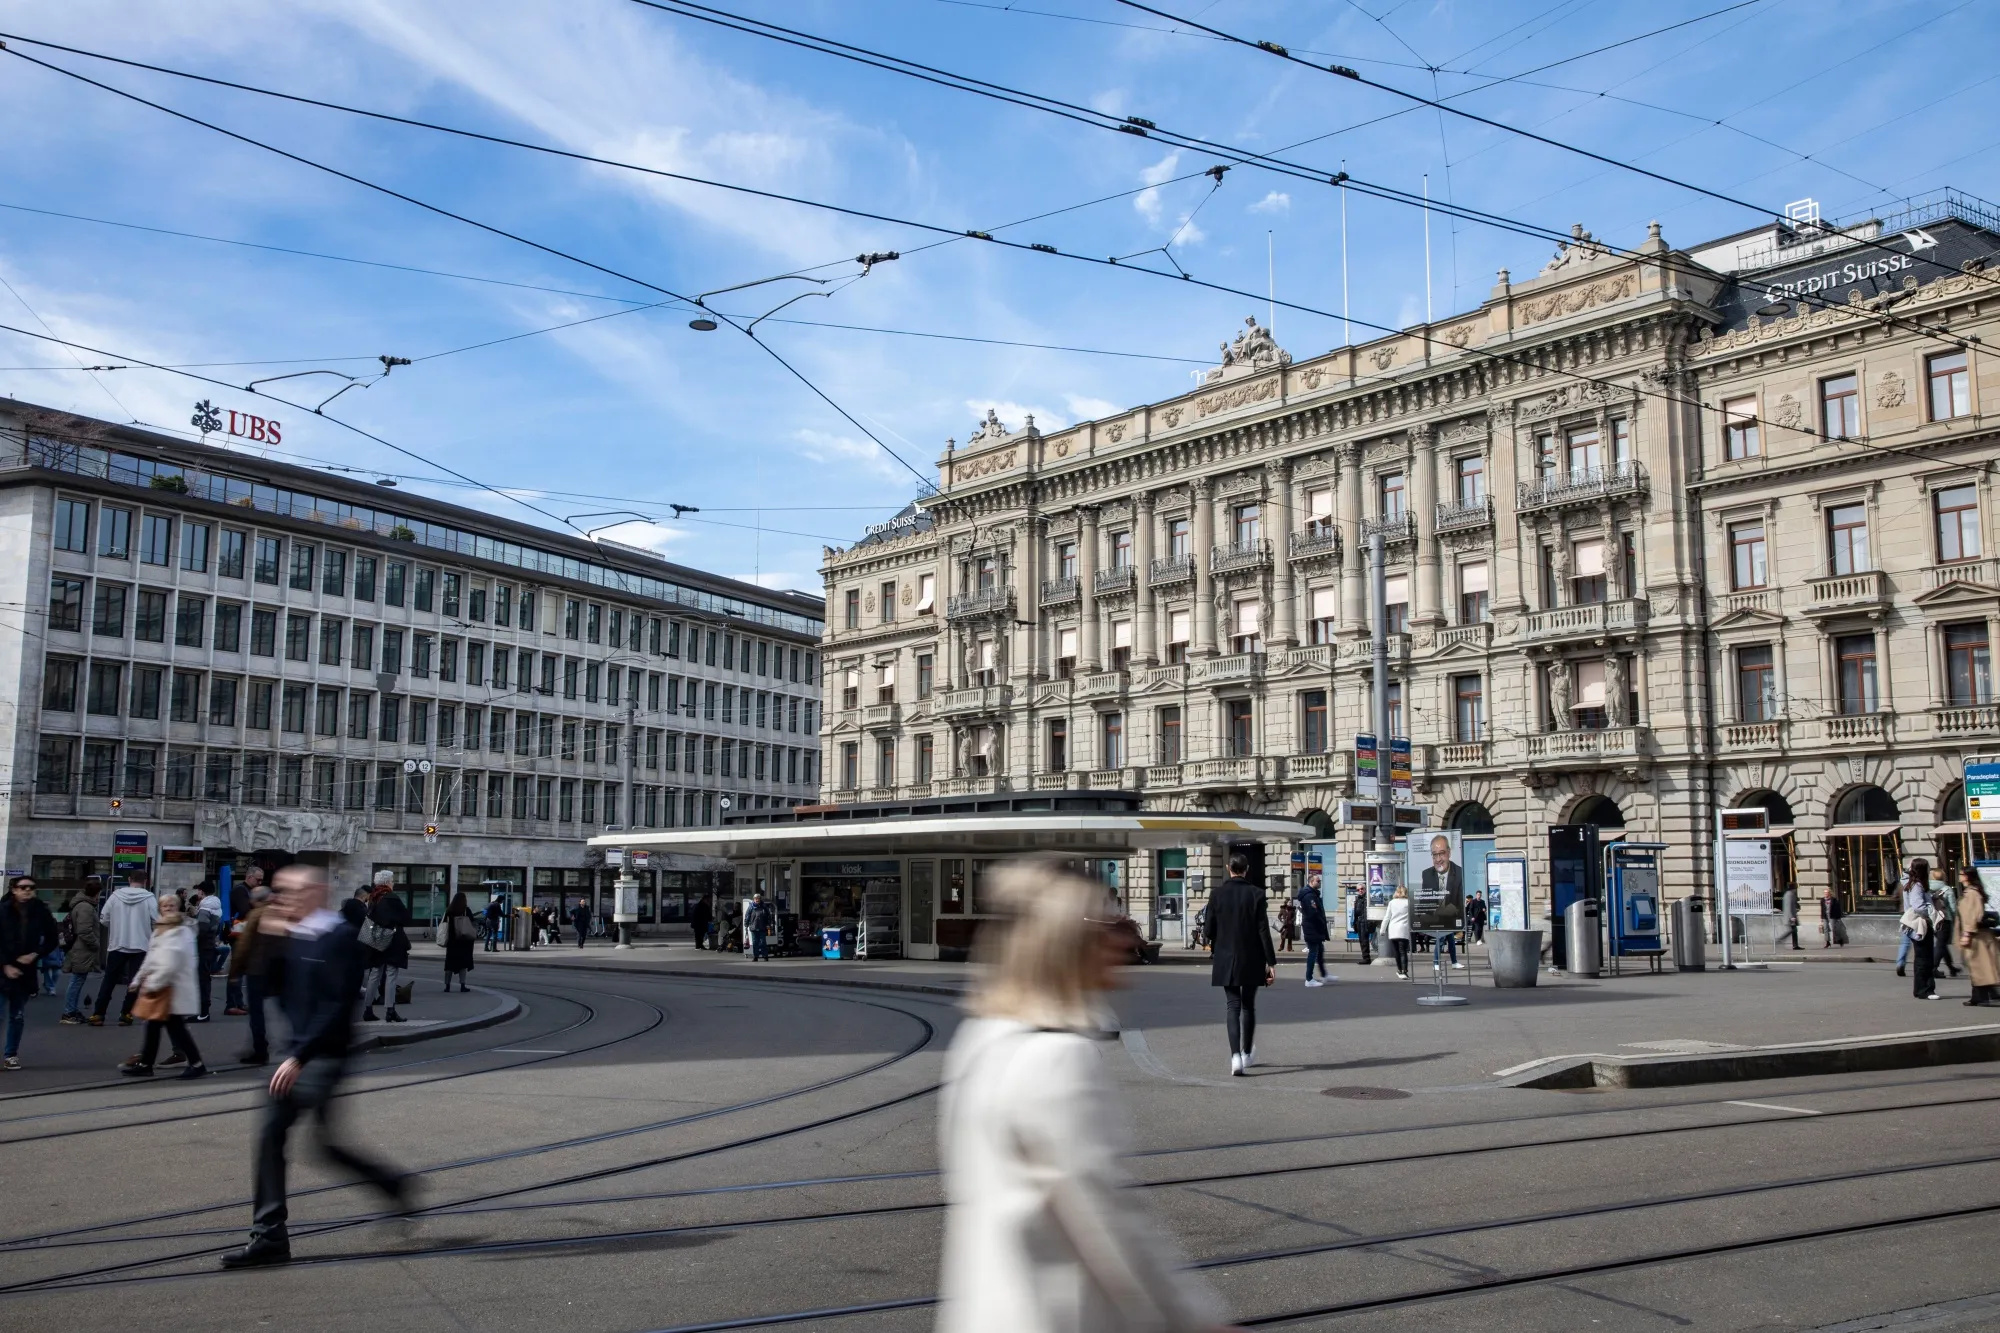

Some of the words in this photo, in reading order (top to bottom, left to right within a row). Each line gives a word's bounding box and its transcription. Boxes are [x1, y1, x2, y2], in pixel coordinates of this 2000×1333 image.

[1764, 271, 1840, 303] CREDIT
[1843, 253, 1912, 284] SUISSE
[229, 410, 281, 445] UBS
[863, 521, 891, 535] CREDIT
[892, 515, 917, 530] SUISSE
[1972, 787, 1980, 795] 11
[1579, 828, 1584, 841] i
[841, 863, 862, 874] kiosk
